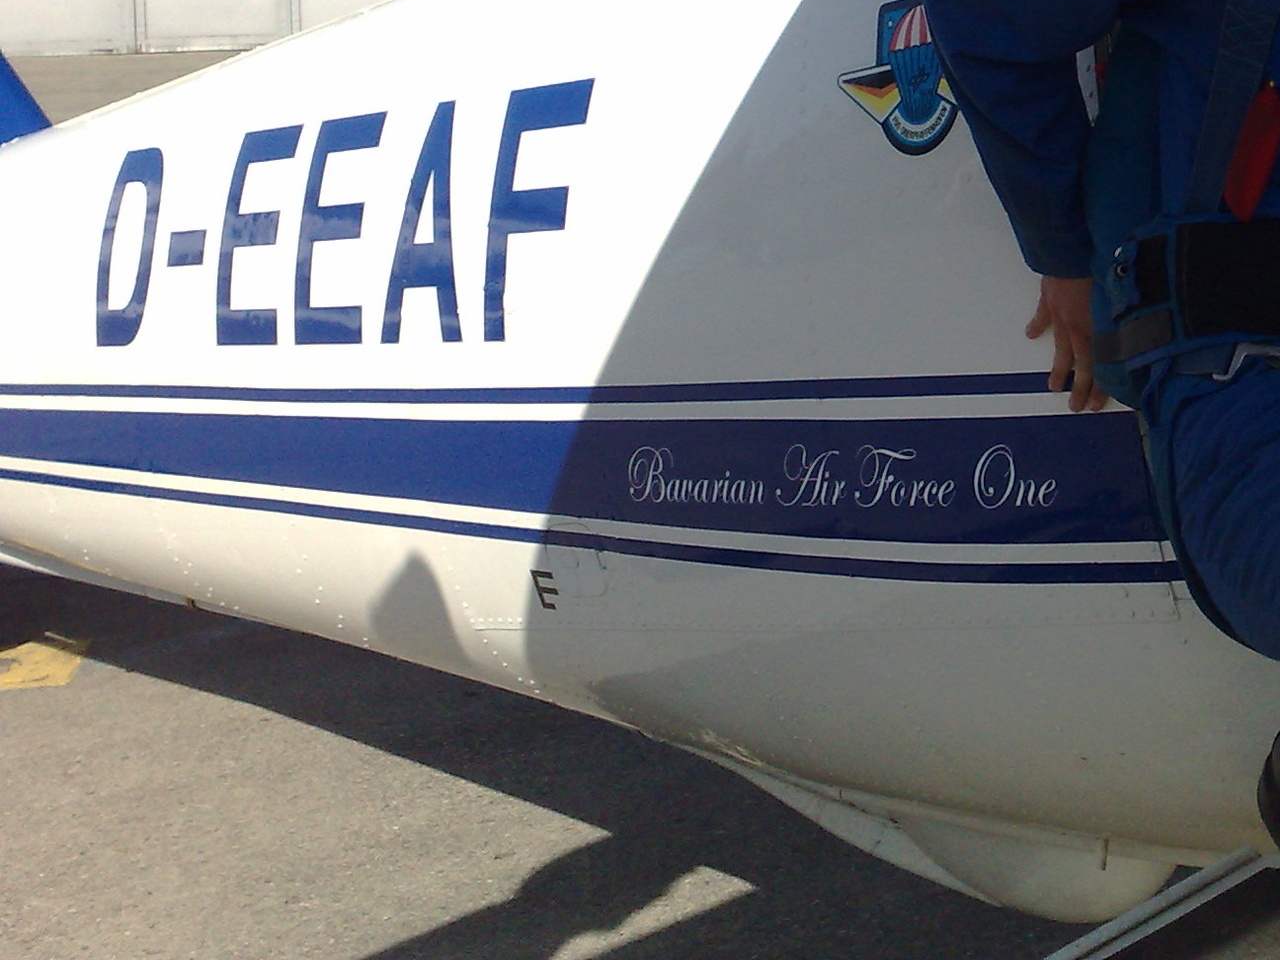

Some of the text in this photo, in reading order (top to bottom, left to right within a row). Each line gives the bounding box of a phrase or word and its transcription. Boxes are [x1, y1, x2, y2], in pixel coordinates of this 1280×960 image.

[96, 78, 596, 347] D-EEAF
[628, 443, 1058, 509] Bavarian Air Force One
[530, 569, 559, 610] E
